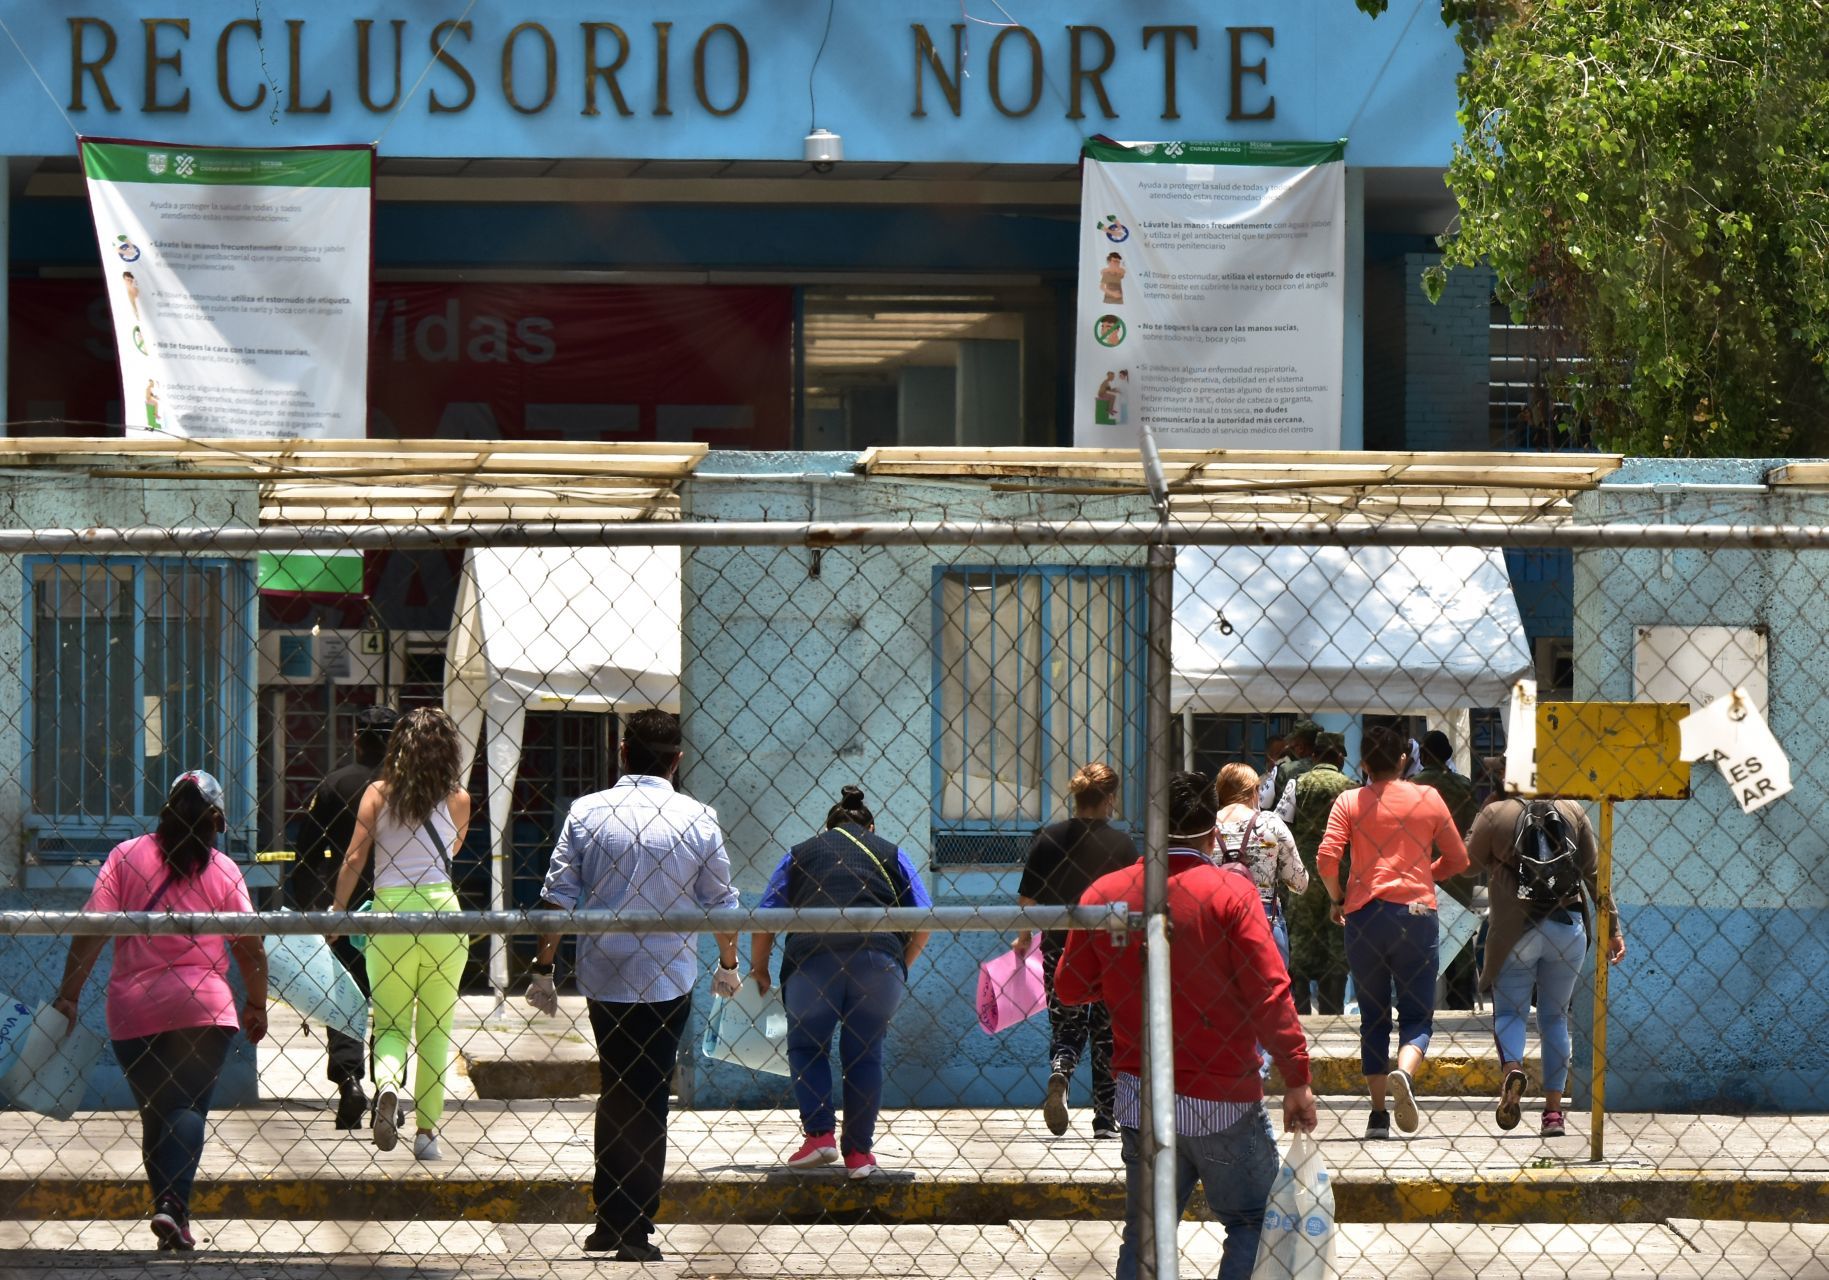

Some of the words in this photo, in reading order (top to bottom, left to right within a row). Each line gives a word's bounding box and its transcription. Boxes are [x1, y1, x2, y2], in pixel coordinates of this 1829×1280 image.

[67, 17, 750, 117] RECLUSORIO
[910, 23, 1277, 121] NORTE
[1138, 182, 1162, 190] Ayuda
[1169, 182, 1200, 192] proteger
[1202, 182, 1210, 190] la
[1210, 182, 1230, 191] salud
[1150, 191, 1192, 200] atendiendo
[1144, 221, 1169, 229] Lávate
[1212, 222, 1272, 230] frecuentemente
[1150, 231, 1172, 240] utiliza
[1172, 232, 1180, 240] el
[1182, 232, 1193, 240] gel
[1194, 232, 1240, 240] antibacterial
[1177, 242, 1226, 250] penitenciario
[1144, 271, 1151, 279] Al
[1178, 273, 1220, 281] estornudar,
[1222, 272, 1246, 280] utiliza
[1248, 272, 1254, 280] el
[1256, 272, 1294, 280] estornudo
[1144, 282, 1158, 290] que
[1298, 282, 1304, 290] el
[1171, 292, 1182, 300] del
[1164, 324, 1190, 332] toques
[1192, 324, 1200, 332] la
[1234, 324, 1246, 332] las
[1274, 324, 1299, 332] sucias,
[1224, 336, 1230, 344] y
[1230, 336, 1246, 344] ojos
[1182, 366, 1206, 375] alguna
[1208, 366, 1252, 374] enfermedad
[1222, 376, 1256, 384] debilidad
[1268, 376, 1276, 384] el
[1276, 376, 1304, 384] sistema
[1200, 387, 1236, 395] presentas
[1237, 387, 1262, 396] alguno
[1266, 386, 1274, 394] de
[1216, 396, 1235, 404] dolor
[1236, 396, 1246, 404] de
[1247, 396, 1272, 404] cabeza
[1193, 406, 1212, 414] nasal
[1265, 406, 1288, 414] dudes
[1152, 416, 1200, 424] comunicarlo
[1208, 416, 1215, 424] la
[1216, 416, 1255, 424] autoridad
[1256, 416, 1273, 424] más
[1170, 426, 1210, 434] canalizado
[1220, 426, 1248, 434] servicio
[1250, 426, 1278, 434] médico
[1278, 426, 1290, 434] del
[1291, 426, 1314, 434] centro
[367, 635, 378, 652] 4
[1743, 778, 1776, 807] AR
